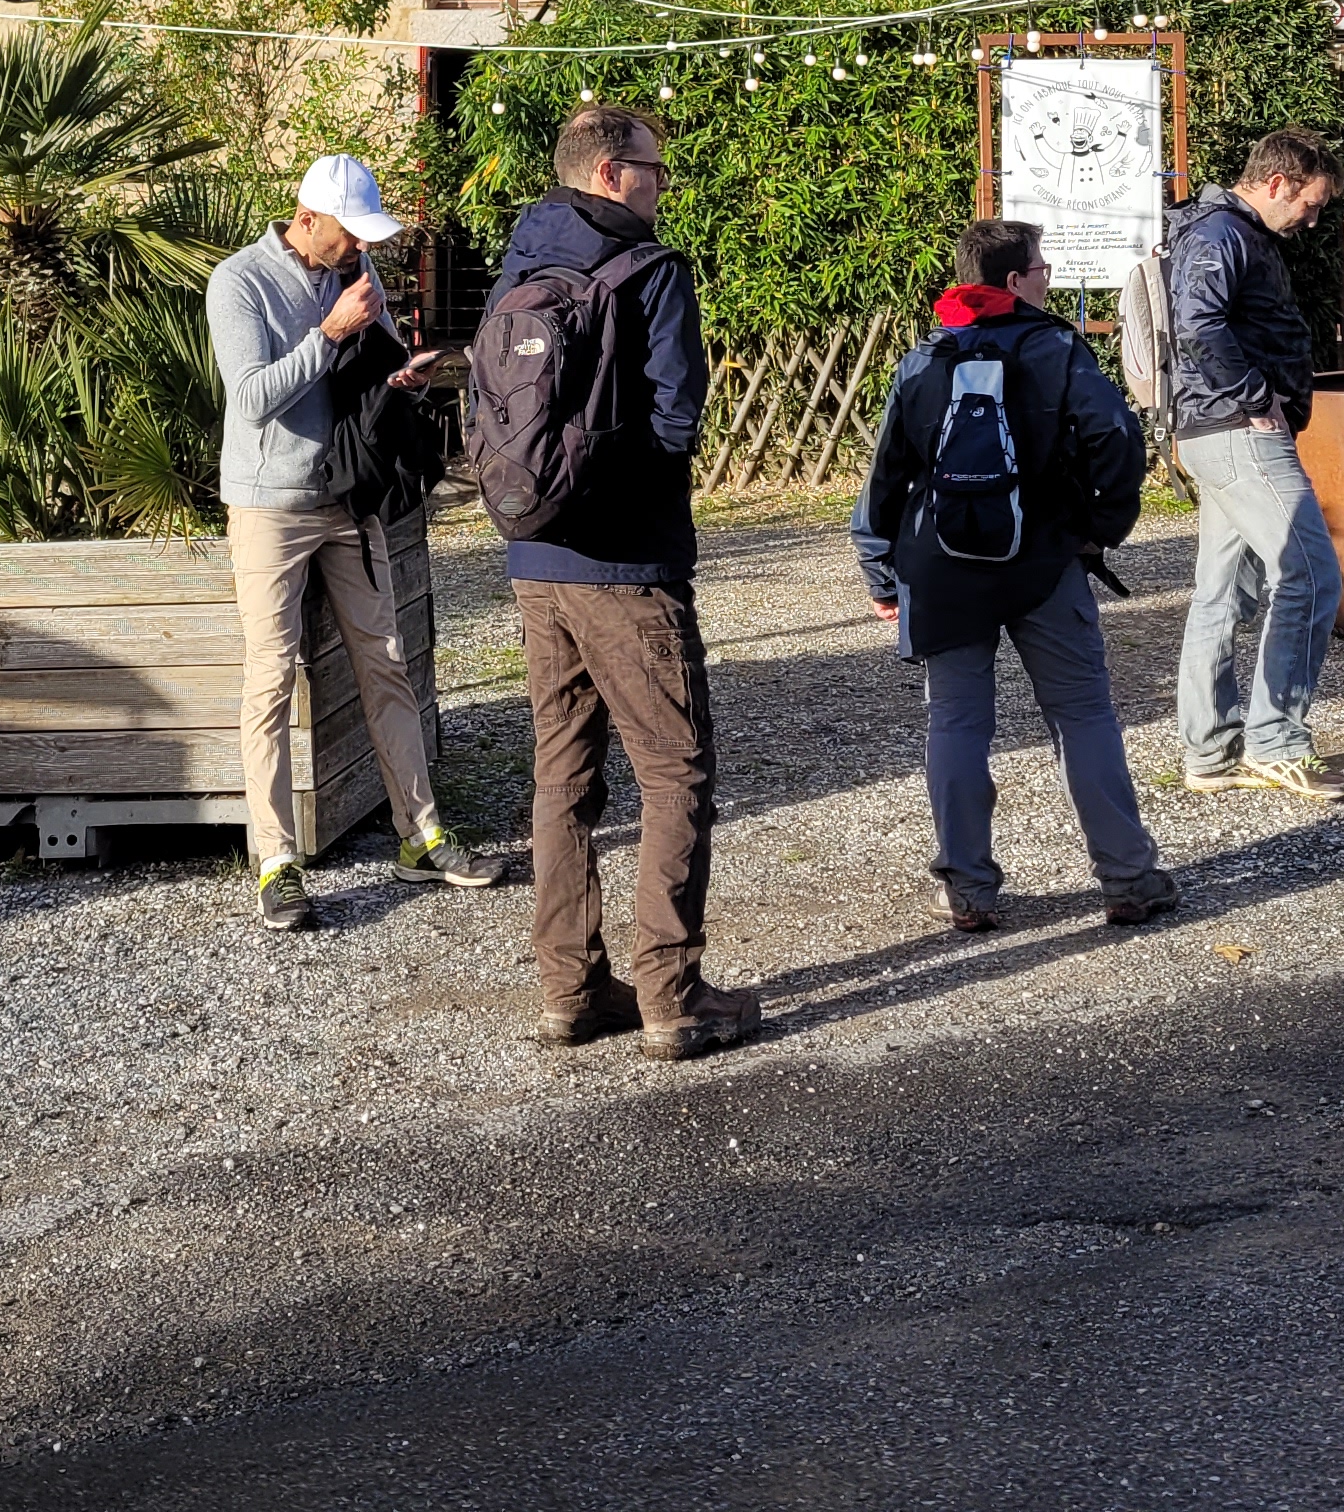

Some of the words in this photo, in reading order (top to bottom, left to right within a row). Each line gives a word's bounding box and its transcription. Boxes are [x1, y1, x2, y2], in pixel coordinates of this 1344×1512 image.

[1012, 113, 1025, 126] ICI
[1019, 99, 1034, 113] ON
[1033, 80, 1072, 102] FABRIQUE
[1077, 79, 1100, 89] TOUT
[1102, 84, 1126, 102] NOUS
[1032, 184, 1063, 207] CUISINE
[1066, 182, 1132, 211] RÉCONFORTANTE
